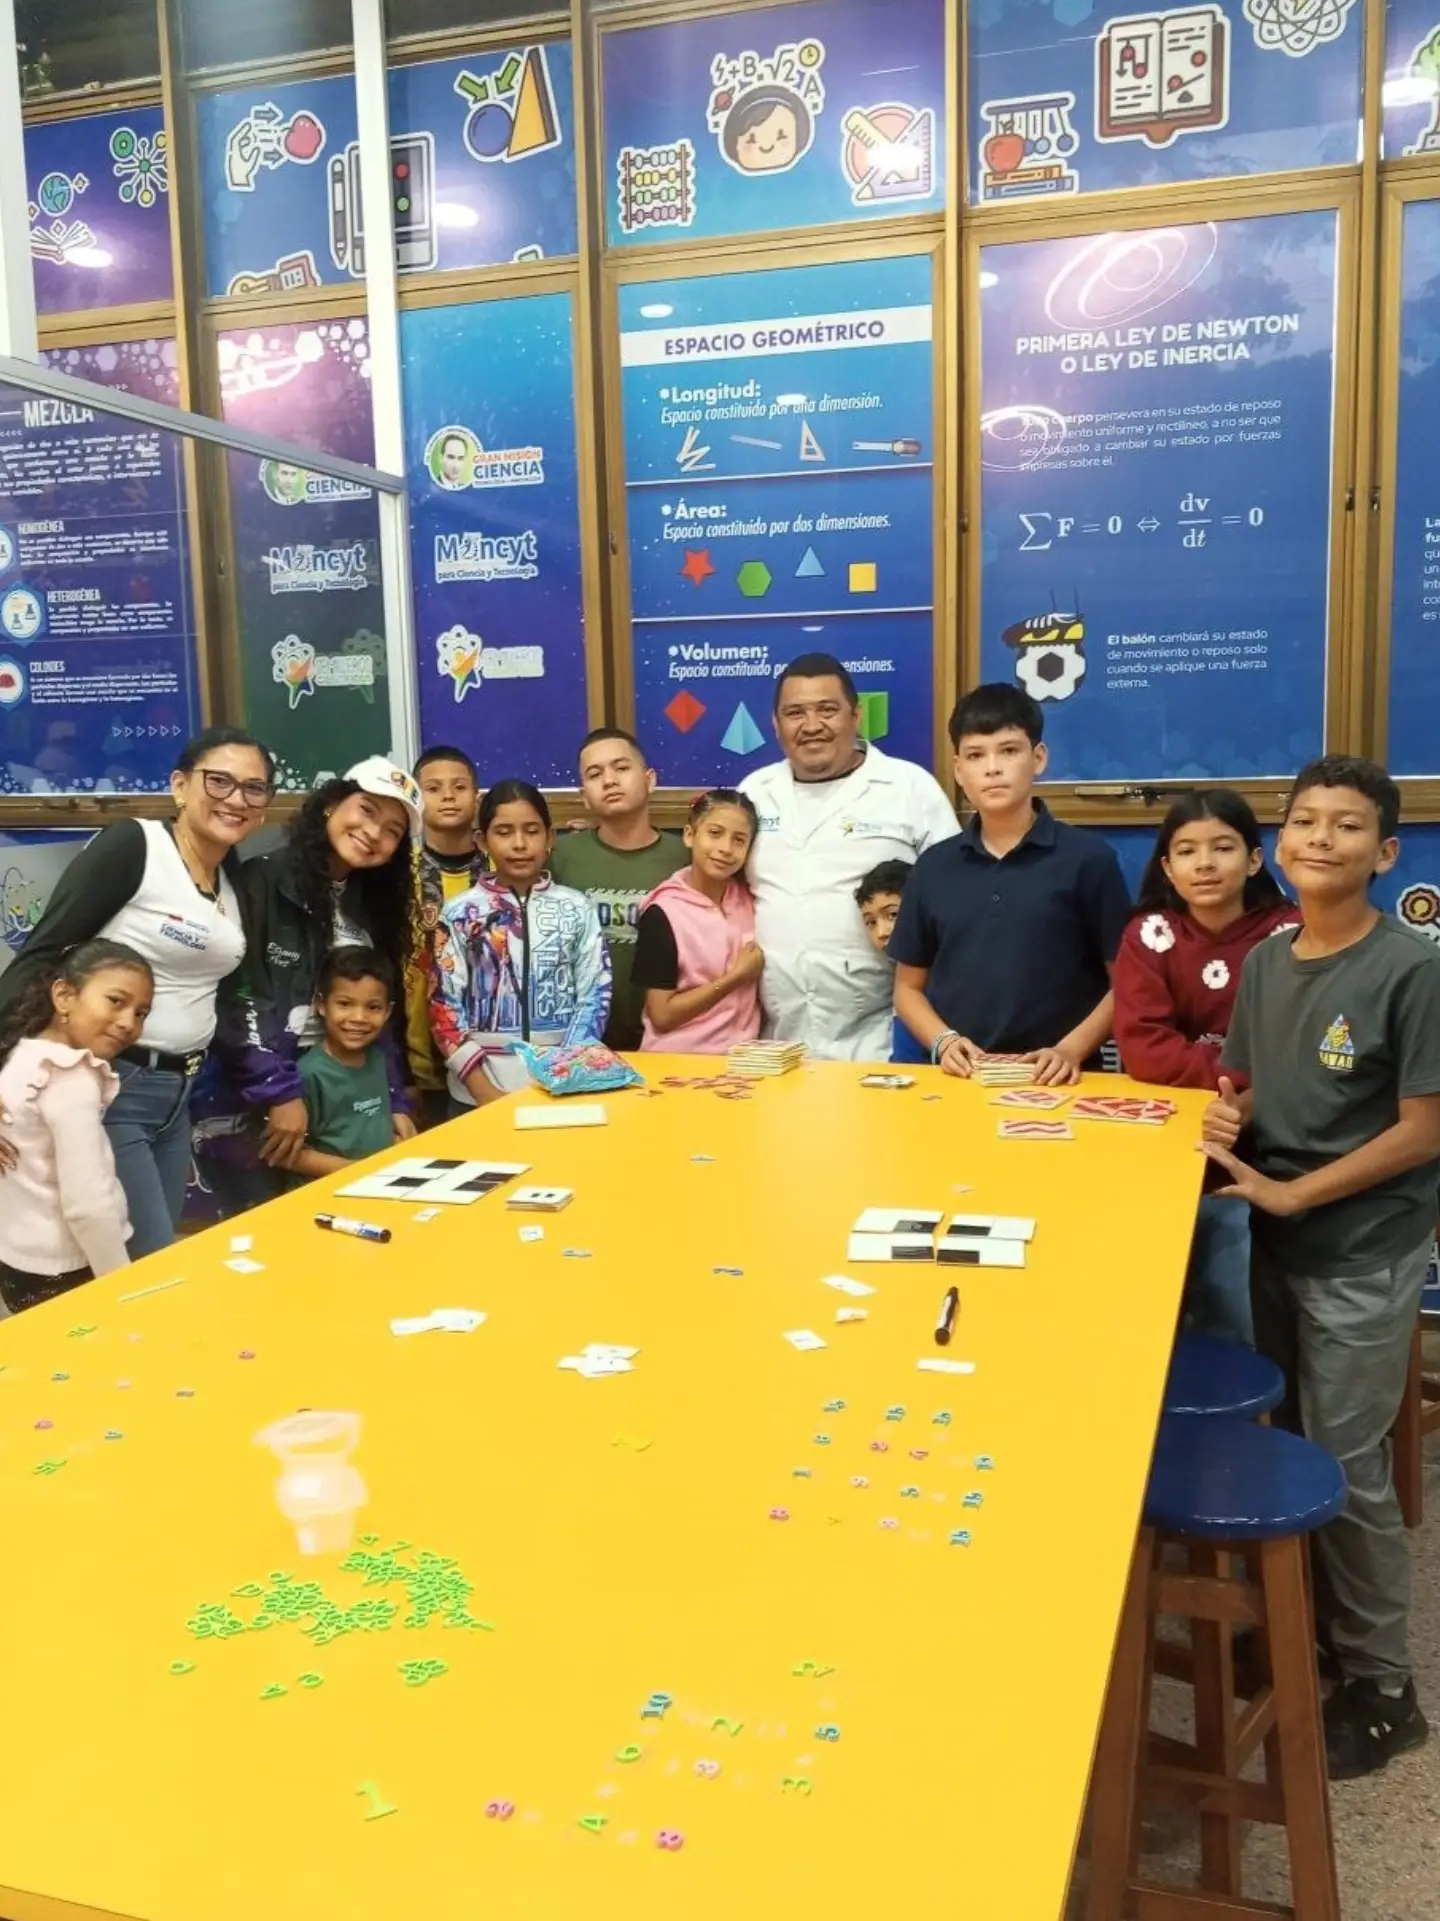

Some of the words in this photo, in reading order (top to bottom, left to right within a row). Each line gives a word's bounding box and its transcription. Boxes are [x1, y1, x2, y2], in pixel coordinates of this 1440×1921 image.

[664, 333, 746, 356] ESPACIO
[752, 320, 886, 349] GEOMÉTRICO
[1016, 332, 1110, 355] PRIMERA
[1115, 326, 1157, 348] LEY
[1162, 323, 1192, 343] DE
[1197, 313, 1299, 340] NEWTON
[1060, 356, 1078, 374] O
[1082, 352, 1123, 372] LEY
[1128, 349, 1158, 369] DE
[1163, 341, 1251, 366] INERCIA
[24, 399, 95, 428] MEZCLA
[661, 407, 702, 428] Espacio
[705, 399, 767, 420] constituido
[818, 391, 884, 413] dimensión.
[1095, 409, 1150, 423] persevera
[1151, 408, 1167, 418] en
[1168, 406, 1181, 417] su
[1182, 402, 1222, 416] estado
[1224, 401, 1239, 413] de
[1241, 399, 1282, 413] reposo
[1095, 424, 1145, 437] uniforme
[1220, 418, 1237, 428] no
[1238, 416, 1257, 427] ser
[1259, 415, 1281, 427] que
[1104, 438, 1148, 450] cambiar
[1152, 438, 1167, 448] su
[1171, 434, 1210, 446] estado
[1214, 433, 1235, 446] por
[1239, 429, 1282, 441] fuerzas
[472, 454, 501, 464] GRAN
[473, 460, 541, 479] CIENCIA
[1070, 456, 1101, 468] sobre
[674, 497, 728, 519] Área:
[662, 522, 704, 543] Espacio
[706, 516, 767, 537] constituido
[769, 520, 789, 538] por
[793, 513, 813, 533] dos
[815, 512, 892, 532] dimensiones.
[1107, 635, 1119, 645] El
[1122, 633, 1156, 645] balón
[1159, 630, 1210, 643] cambiará
[1212, 631, 1226, 641] su
[1228, 629, 1269, 640] estado
[680, 642, 769, 661] Volumen:
[1106, 650, 1122, 661] de
[1124, 647, 1190, 659] movimiento
[1202, 646, 1241, 658] reposo
[1243, 644, 1269, 655] solo
[669, 661, 710, 682] Espacio
[712, 658, 772, 677] constituido
[1106, 662, 1148, 675] cuando
[1149, 663, 1164, 673] se
[1165, 660, 1206, 674] aplique
[1208, 660, 1229, 670] una
[1231, 659, 1268, 669] fuerza
